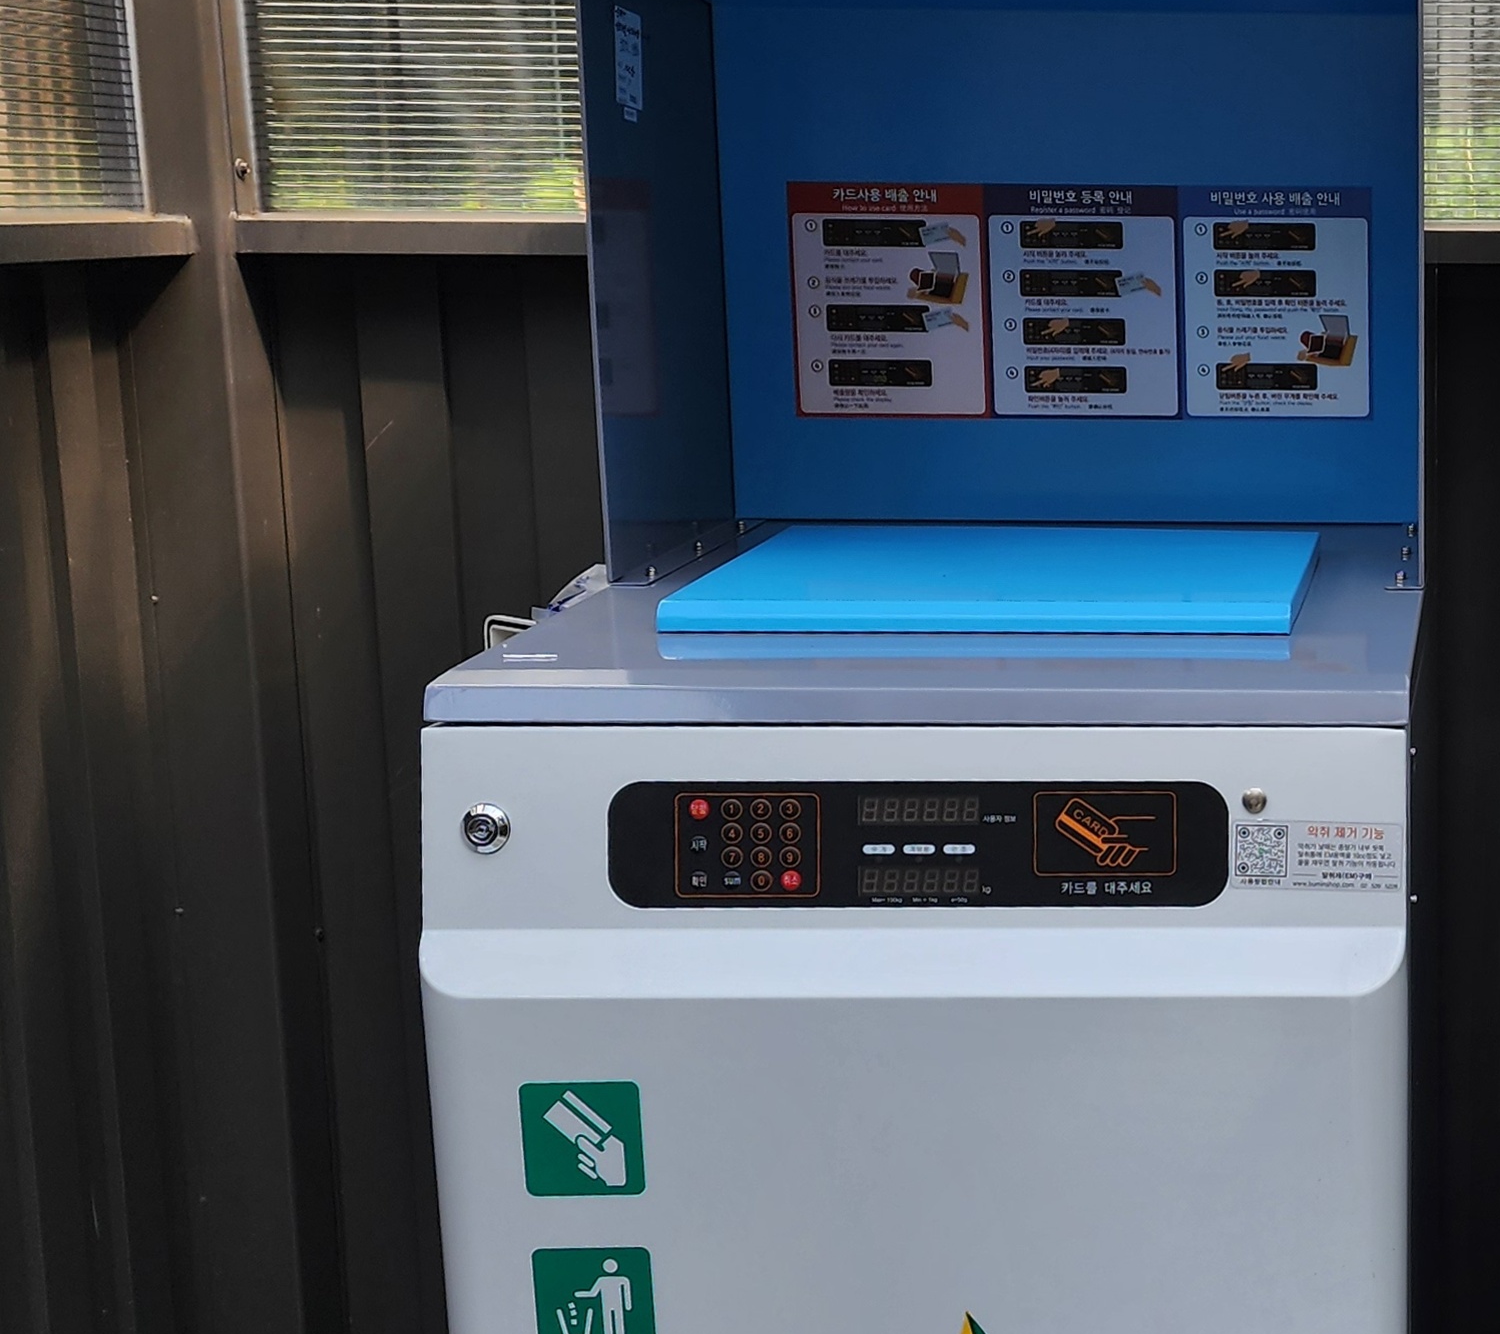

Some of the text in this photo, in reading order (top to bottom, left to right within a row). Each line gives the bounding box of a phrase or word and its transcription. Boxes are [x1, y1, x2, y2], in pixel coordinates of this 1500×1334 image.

[832, 188, 938, 204] 카드사용 배출 안내
[1029, 190, 1133, 205] 비밀번호 등록 안내
[1210, 191, 1342, 207] 비밀번호 사용 배출 안내
[1030, 206, 1057, 216] Register
[1064, 206, 1096, 216] password
[1253, 208, 1285, 217] password
[757, 804, 764, 815] 2
[786, 803, 793, 814] 3
[1073, 809, 1109, 836] CARD
[728, 828, 736, 839] 4
[757, 828, 764, 839] 5
[786, 828, 793, 839] 6
[1307, 825, 1385, 840] 악취 제거 기능
[728, 852, 736, 863] 7
[757, 852, 765, 863] 8
[786, 852, 793, 863] 9
[724, 877, 741, 886] sum
[757, 875, 765, 886] 0
[1061, 881, 1152, 896] 카드를 대주세요
